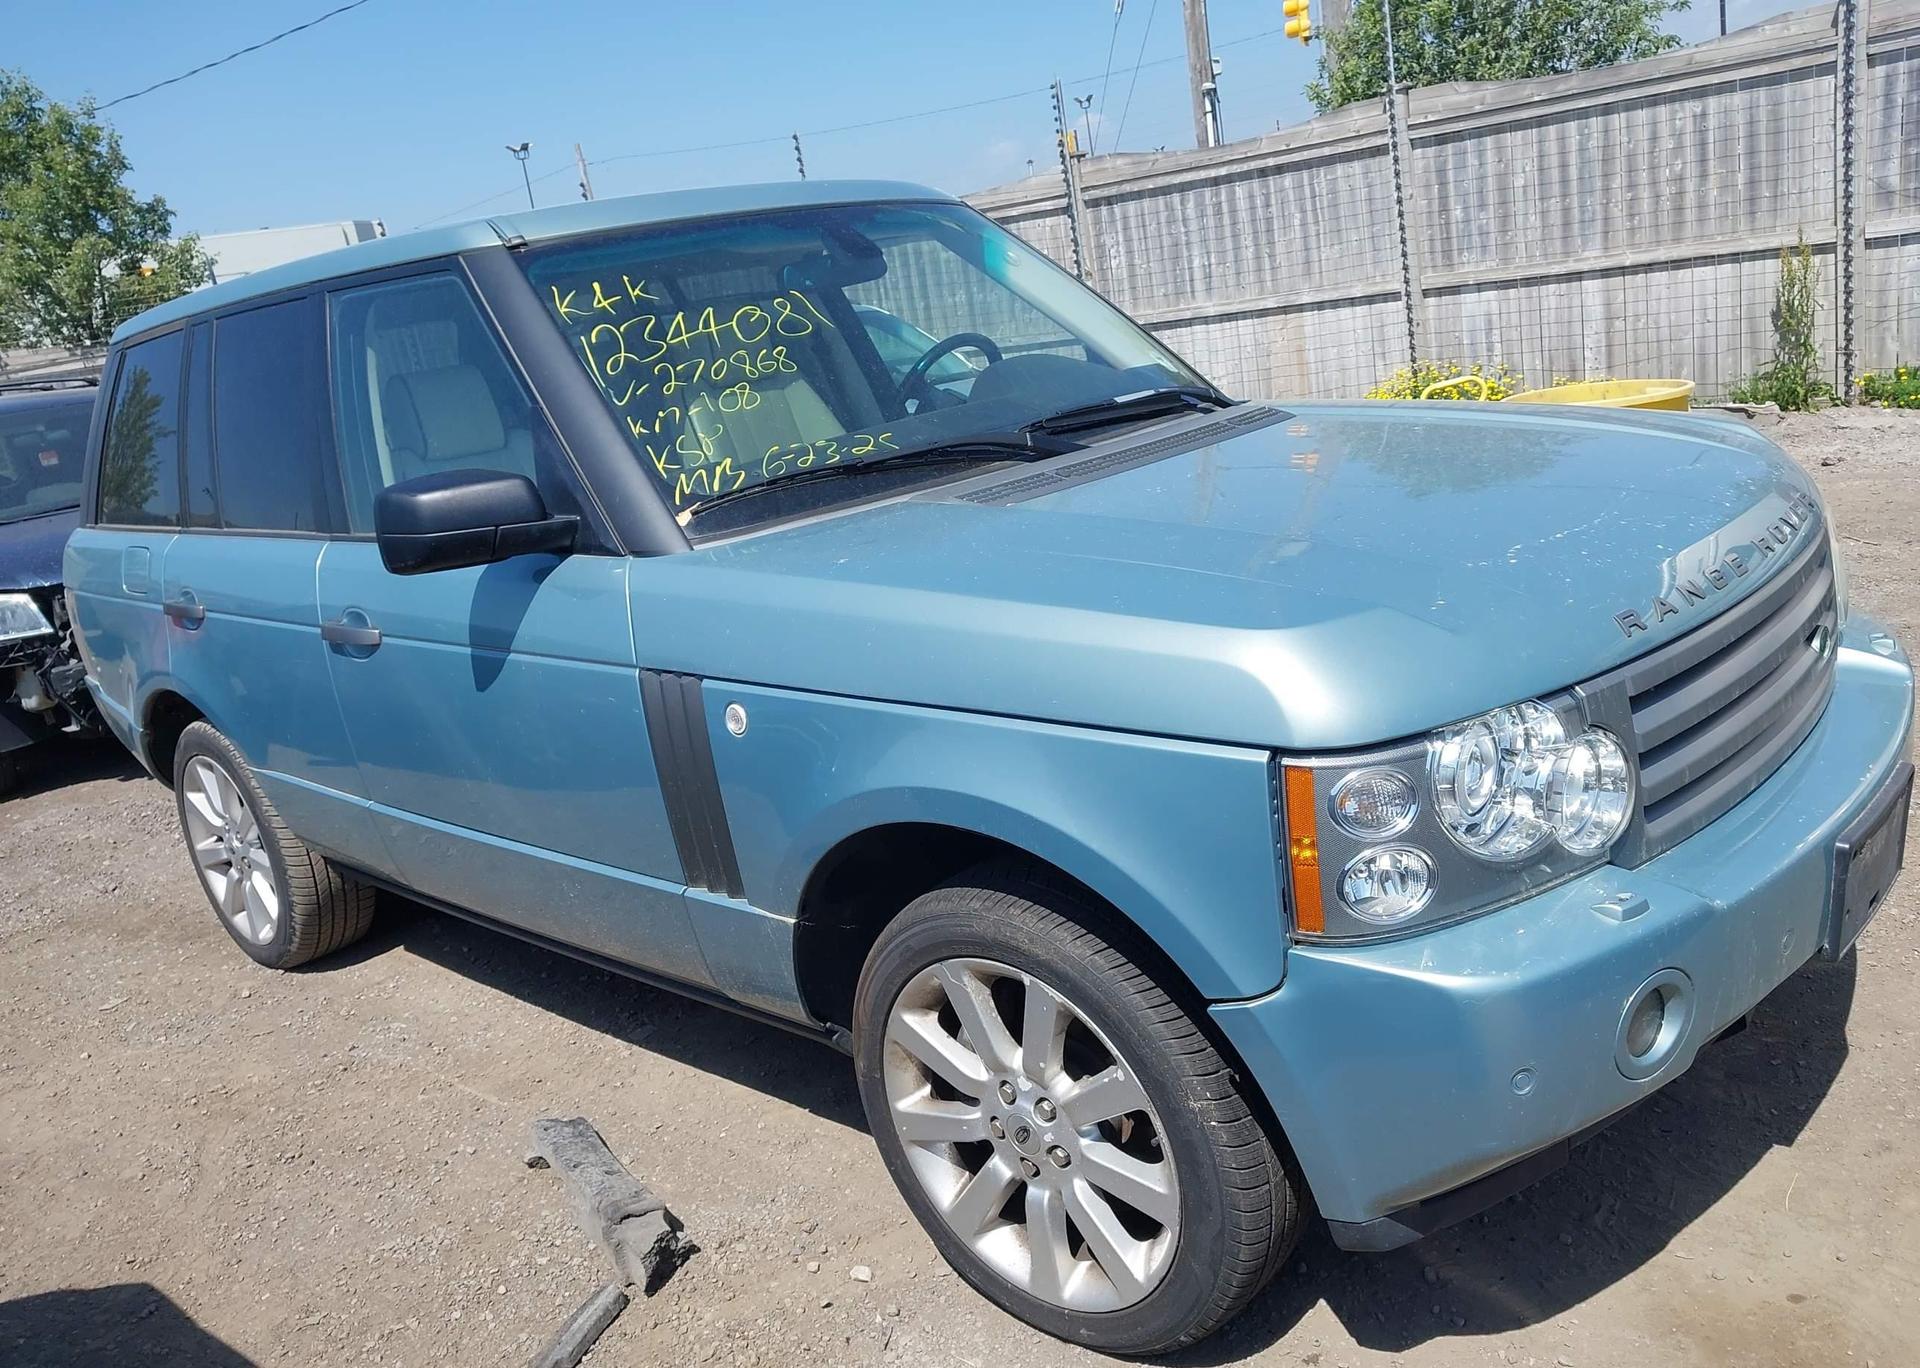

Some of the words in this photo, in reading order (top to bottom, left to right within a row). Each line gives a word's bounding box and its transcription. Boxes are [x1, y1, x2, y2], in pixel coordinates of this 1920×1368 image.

[580, 290, 836, 388] 12344081
[1613, 552, 1749, 638] RANGE
[1750, 493, 1817, 557] ROVER
